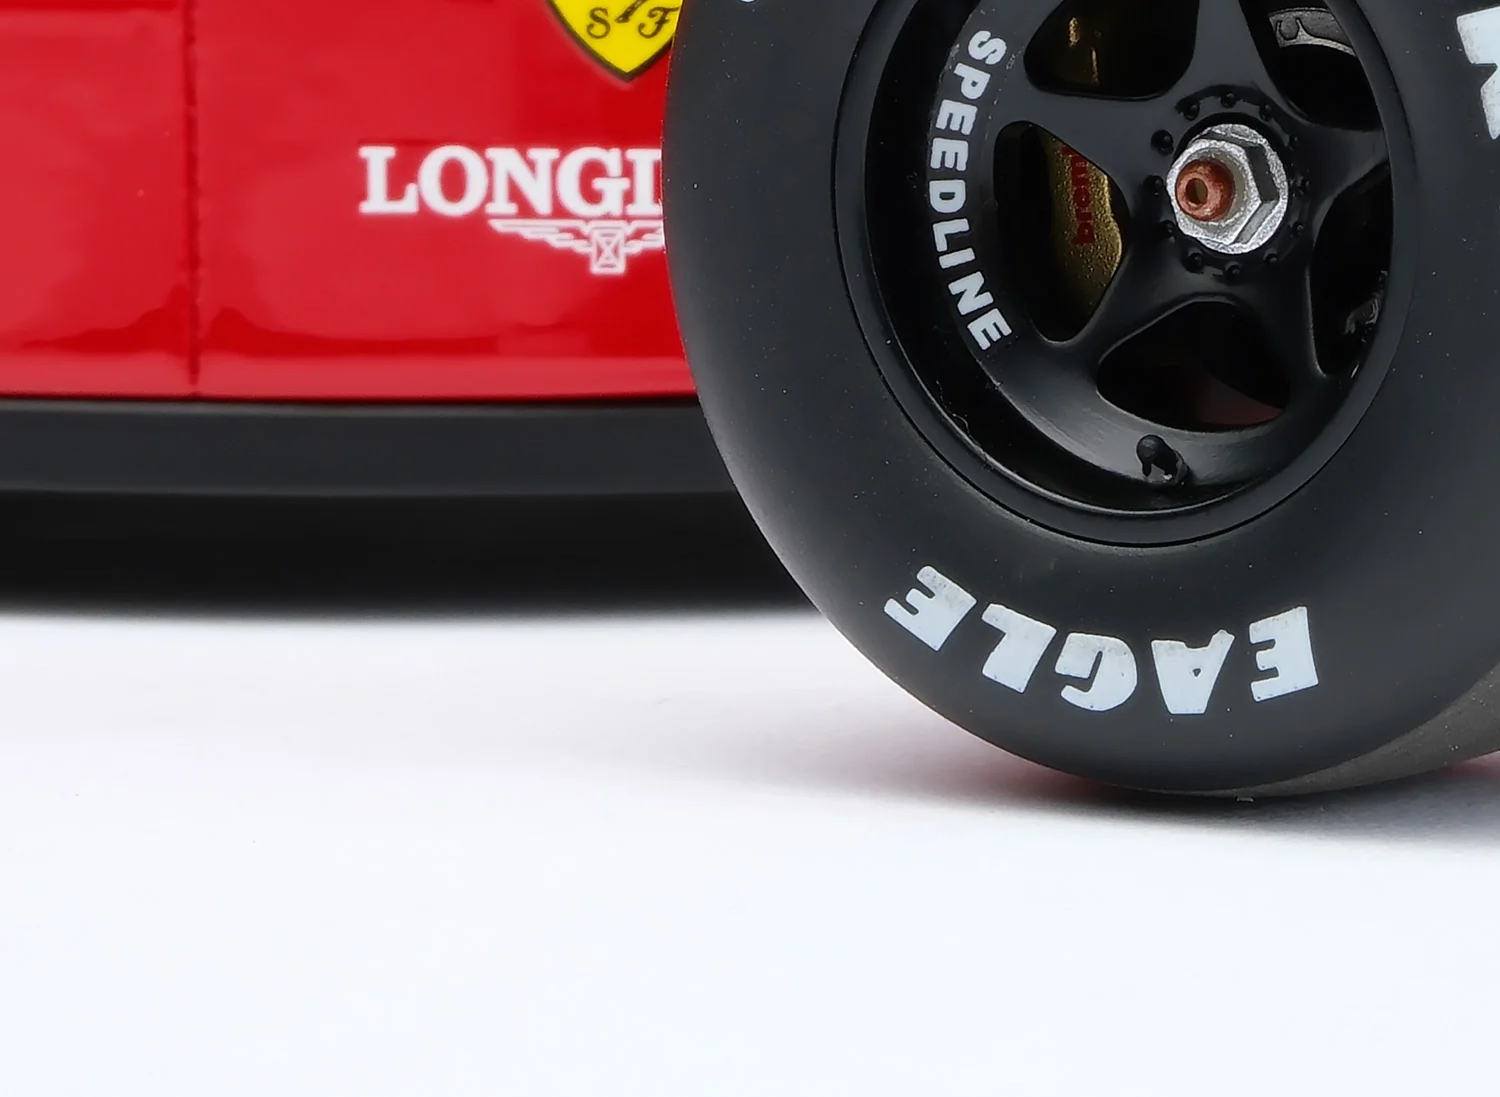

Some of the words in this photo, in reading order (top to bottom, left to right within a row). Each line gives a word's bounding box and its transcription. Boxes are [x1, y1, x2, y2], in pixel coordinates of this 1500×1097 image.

[586, 6, 611, 39] S
[637, 6, 680, 39] F
[928, 29, 1013, 351] SPEEDLINE
[883, 564, 1319, 715] EAGLE
